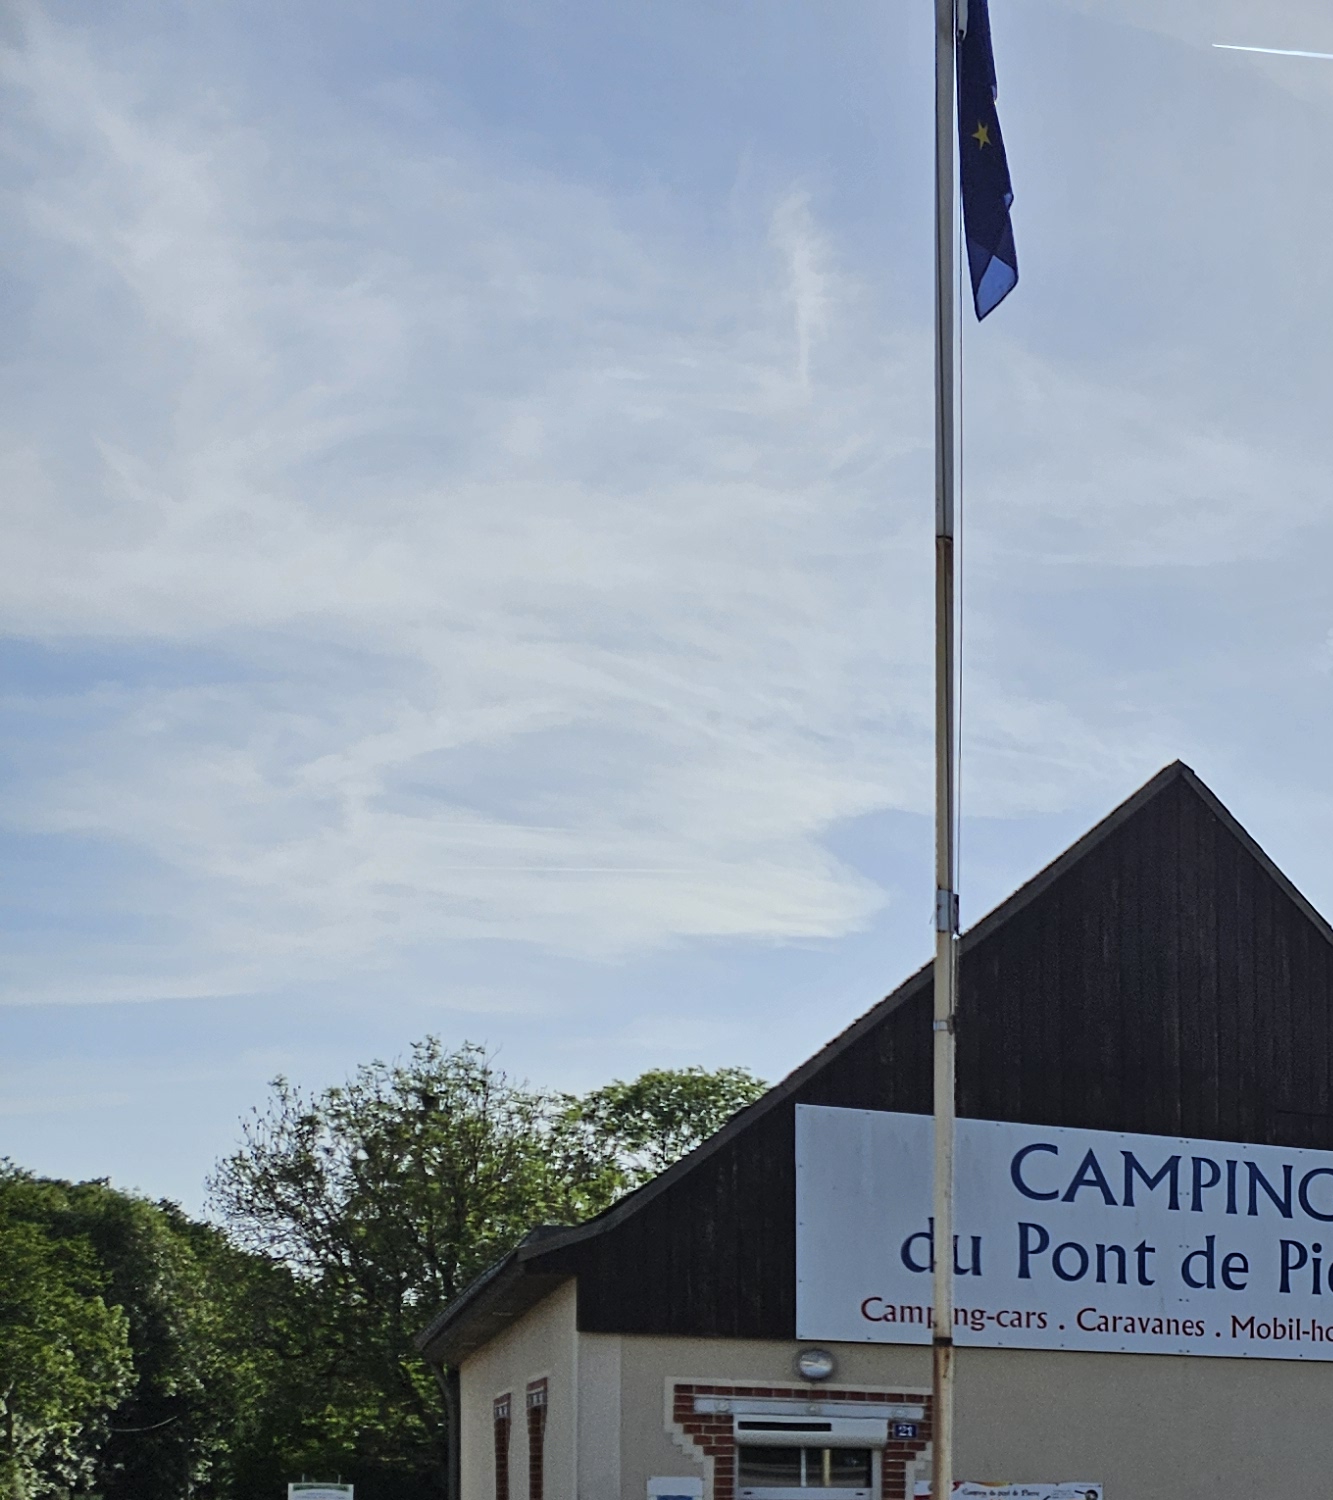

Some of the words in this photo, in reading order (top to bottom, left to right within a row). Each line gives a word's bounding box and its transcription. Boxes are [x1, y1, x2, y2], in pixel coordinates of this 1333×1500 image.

[900, 1217, 983, 1277] du
[1016, 1221, 1156, 1286] Pont
[1180, 1234, 1250, 1291] de
[860, 1296, 1048, 1331] Camng-cars
[1076, 1307, 1205, 1337] Caravanes
[898, 1424, 913, 1437] 21
